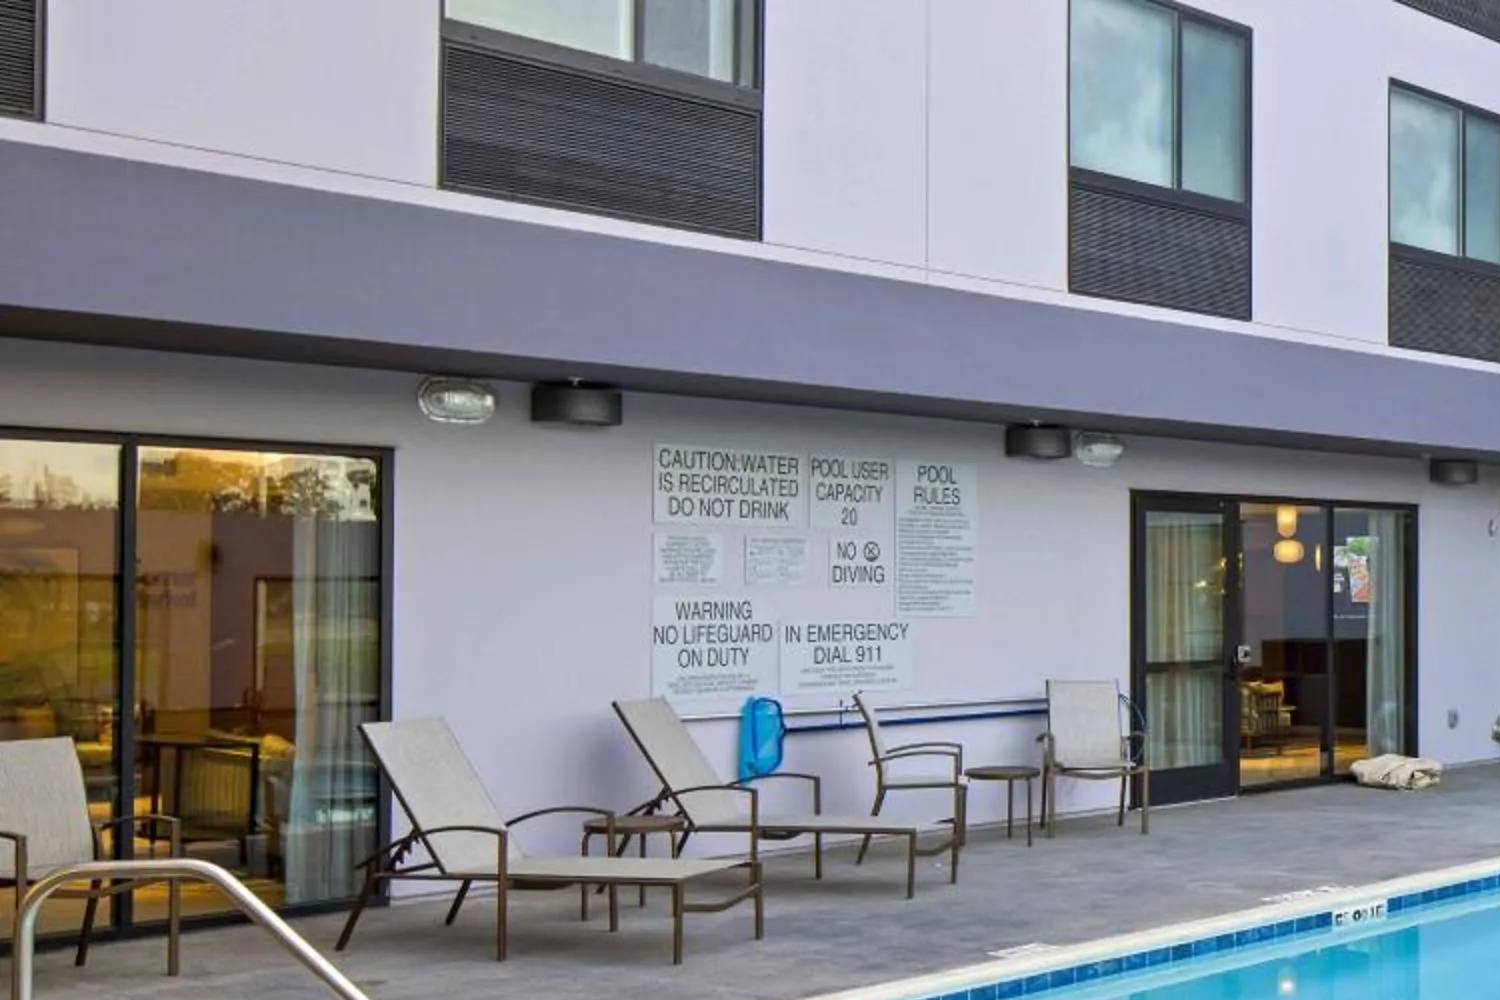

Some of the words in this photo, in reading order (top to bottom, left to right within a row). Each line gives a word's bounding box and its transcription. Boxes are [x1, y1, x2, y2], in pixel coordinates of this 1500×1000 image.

[742, 454, 799, 475] WATER
[811, 457, 848, 479] POOL
[852, 461, 889, 480] USER
[917, 465, 958, 484] POOL
[659, 472, 673, 492] IS
[679, 474, 799, 497] RECIRCULATED
[816, 482, 883, 503] CAPACITY
[914, 486, 961, 505] RULES
[669, 496, 694, 517] DO
[700, 498, 735, 517] NOT
[740, 500, 789, 521] DRINK
[841, 507, 858, 526] 20
[837, 541, 857, 560] NO
[832, 565, 885, 584] DIVING
[675, 601, 752, 620] WARNING
[653, 625, 679, 645] NO
[683, 624, 773, 645] LIFEGUARD
[785, 625, 801, 643] IN
[807, 623, 909, 642] EMERGENCY
[677, 649, 702, 668] ON
[707, 648, 750, 667] DUTY
[813, 645, 852, 665] DIAL
[856, 646, 882, 663] 911
